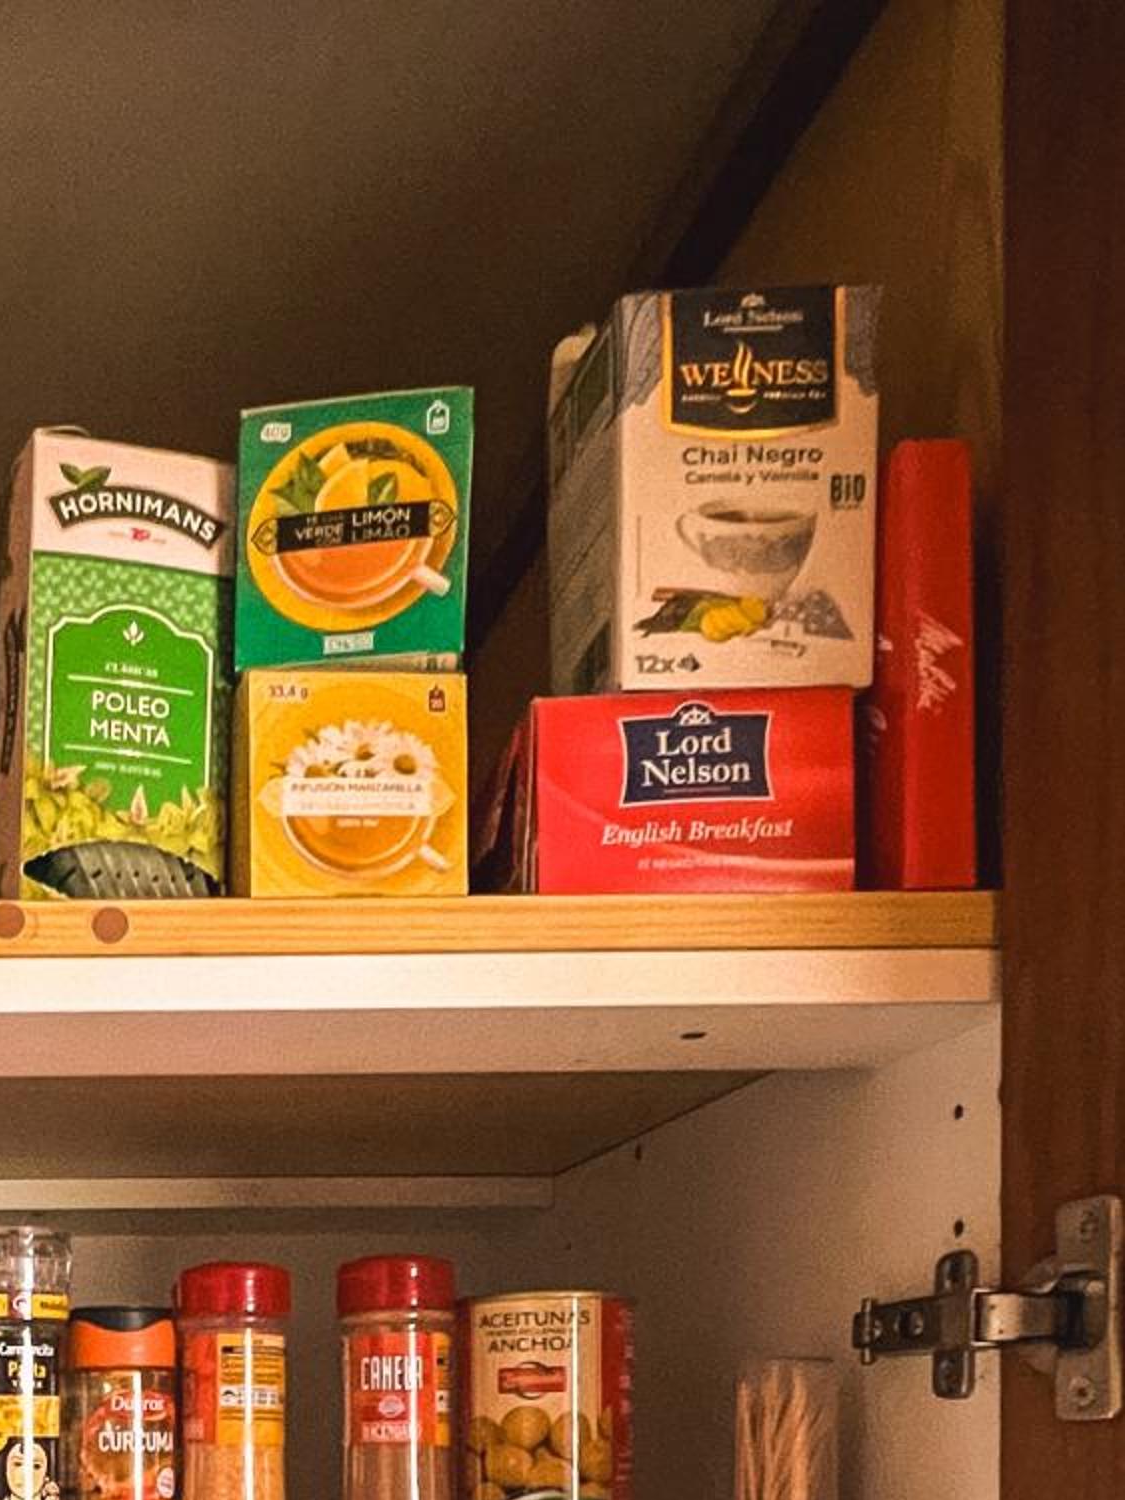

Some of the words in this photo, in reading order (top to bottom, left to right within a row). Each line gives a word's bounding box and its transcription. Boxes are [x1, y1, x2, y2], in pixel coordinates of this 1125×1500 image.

[682, 444, 738, 466] Chai
[746, 443, 824, 468] Negro
[59, 492, 216, 541] HORNIMANS
[295, 522, 345, 541] VERDE
[92, 690, 170, 719] POLEO
[90, 717, 170, 748] MENTA
[655, 727, 732, 756] Lord
[641, 757, 751, 787] Nelson
[601, 820, 683, 848] English
[688, 816, 793, 842] Breakfast
[8, 1360, 47, 1379] Pata
[111, 1395, 165, 1412] Duros
